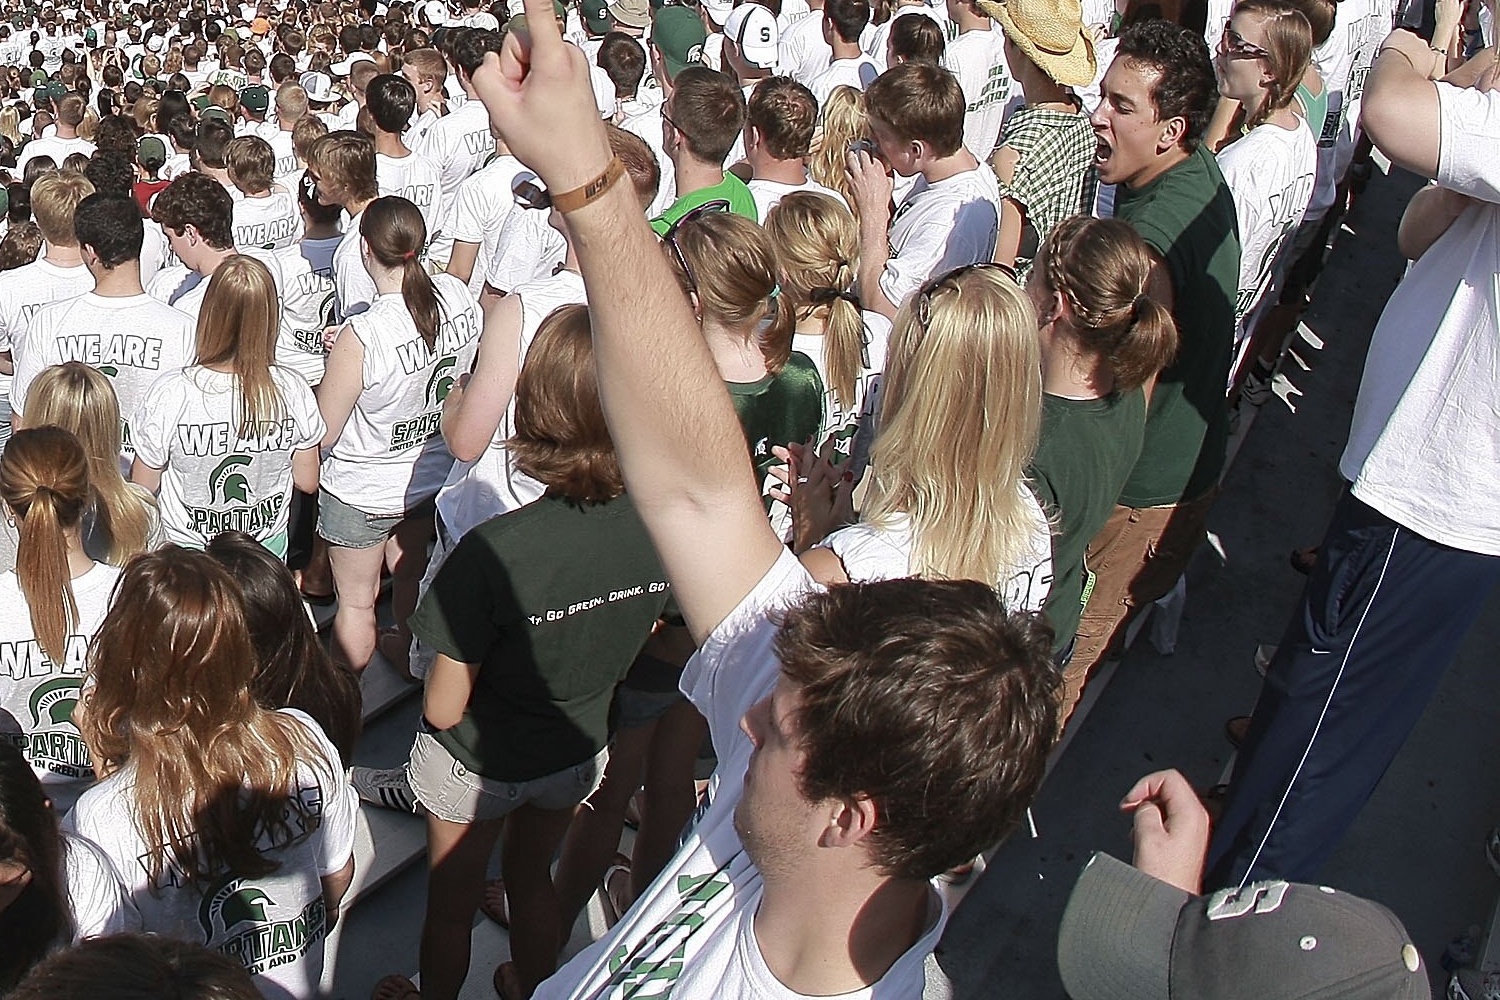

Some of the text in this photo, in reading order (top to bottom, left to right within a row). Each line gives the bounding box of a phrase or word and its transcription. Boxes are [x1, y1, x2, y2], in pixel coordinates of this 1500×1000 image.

[760, 26, 771, 43] S
[238, 217, 297, 246] WE ARE
[298, 269, 332, 295] WE
[439, 305, 478, 356] ARE
[57, 333, 162, 370] WE ARE
[178, 422, 229, 457] WE
[48, 761, 82, 777] GREEN
[267, 953, 297, 971] AND
